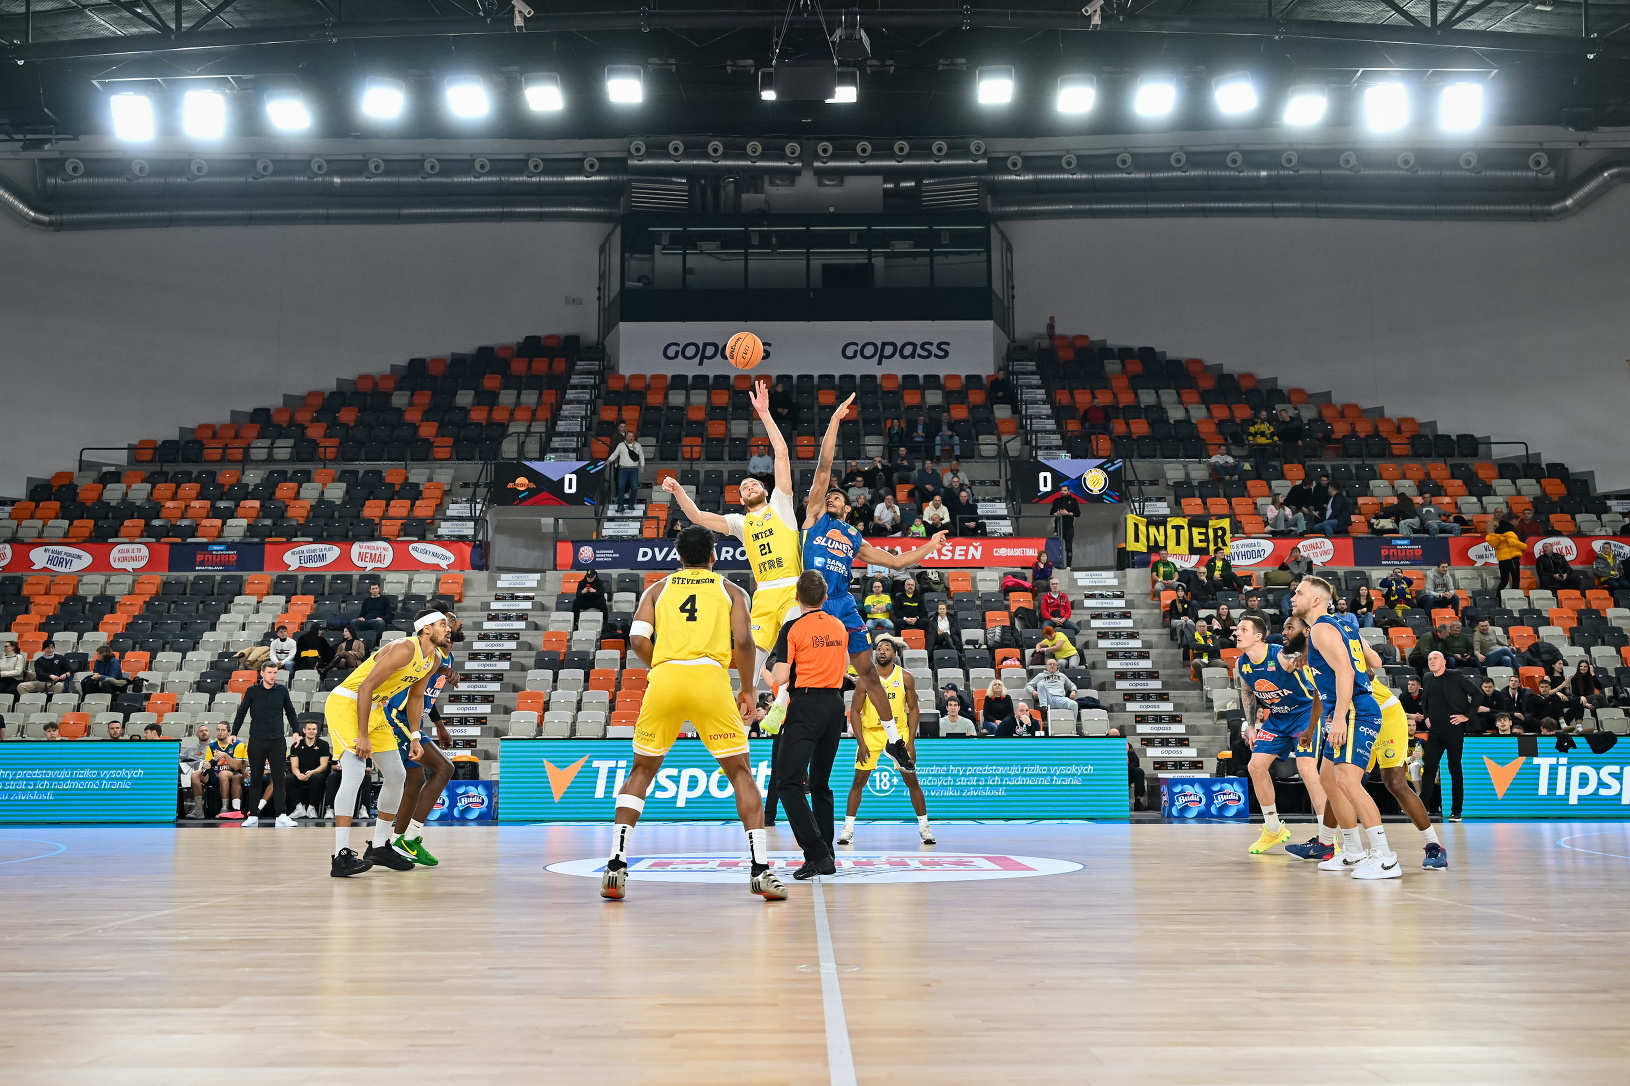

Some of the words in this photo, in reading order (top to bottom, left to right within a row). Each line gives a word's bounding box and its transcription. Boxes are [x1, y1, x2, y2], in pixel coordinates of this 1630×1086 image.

[662, 342, 772, 366] Gops
[564, 473, 577, 494] 0
[1038, 472, 1052, 492] 0
[752, 528, 774, 542] INTER
[1134, 522, 1228, 548] INTER
[759, 542, 772, 556] 21
[46, 555, 73, 569] HORY!
[299, 553, 327, 564] EUROM!
[358, 551, 386, 564] NEMÁ!
[671, 576, 715, 585] STEVENSON
[679, 594, 697, 622] 4
[1242, 664, 1253, 674] 44
[16, 769, 70, 780] predstavujú
[72, 769, 98, 778] riziko
[100, 768, 144, 779] vysokých
[916, 765, 947, 774] zardné
[949, 765, 965, 775] hry
[967, 765, 1021, 776] predstavujú
[1023, 765, 1048, 774] riziko
[1051, 765, 1094, 775] vysokých
[36, 780, 50, 789] ich
[52, 780, 99, 789] nadmerné
[102, 780, 131, 789] hranie
[873, 772, 899, 790] 18+
[956, 777, 977, 785] strát
[988, 776, 1000, 785] ich
[1003, 776, 1050, 785] nadmerné
[1053, 776, 1082, 785] hranie
[930, 788, 960, 796] vzniku
[963, 787, 1006, 796] závislosti.
